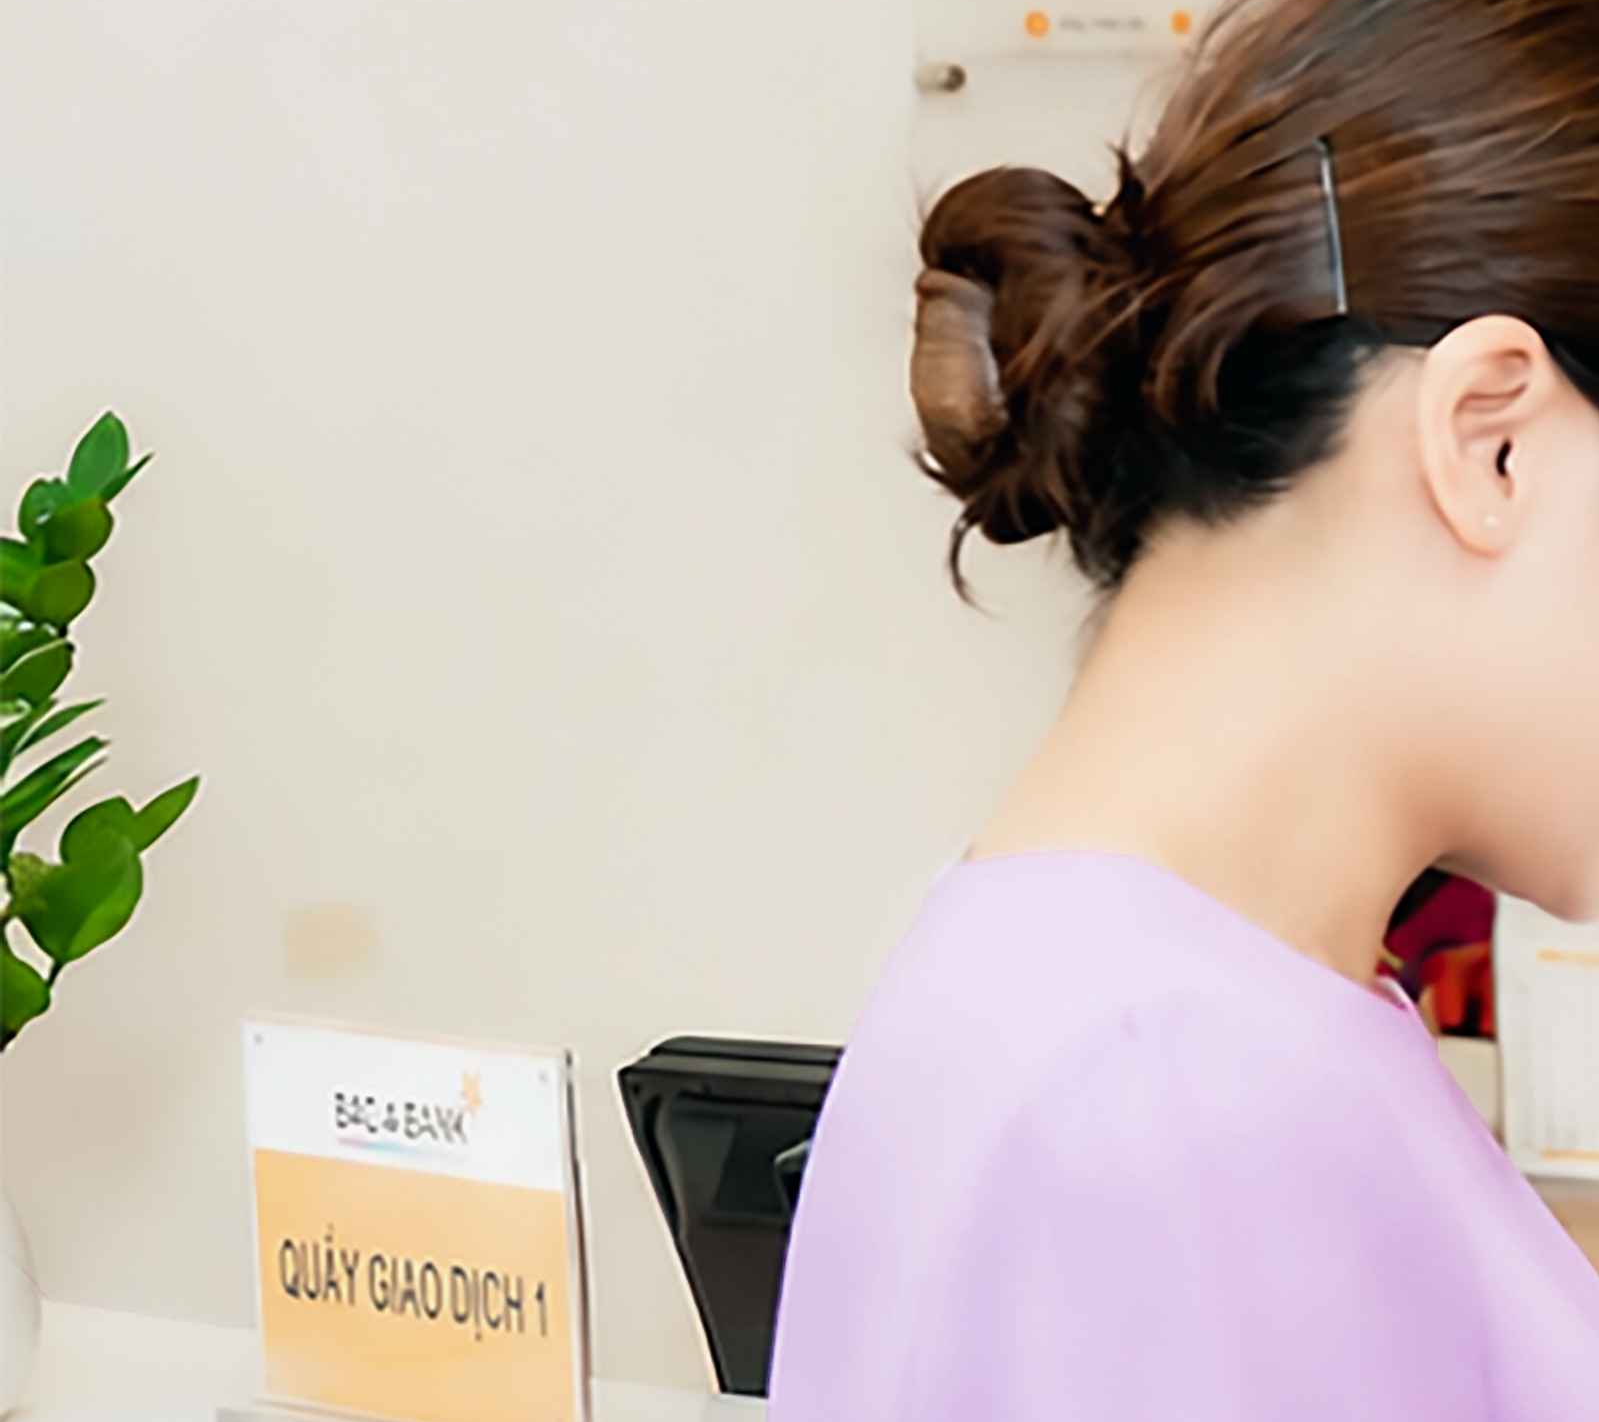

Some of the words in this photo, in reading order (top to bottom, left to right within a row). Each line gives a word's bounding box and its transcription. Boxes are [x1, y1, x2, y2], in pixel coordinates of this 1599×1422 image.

[368, 1253, 443, 1320] GIAO
[450, 1264, 525, 1343] DỊCH
[534, 1281, 548, 1337] 1
